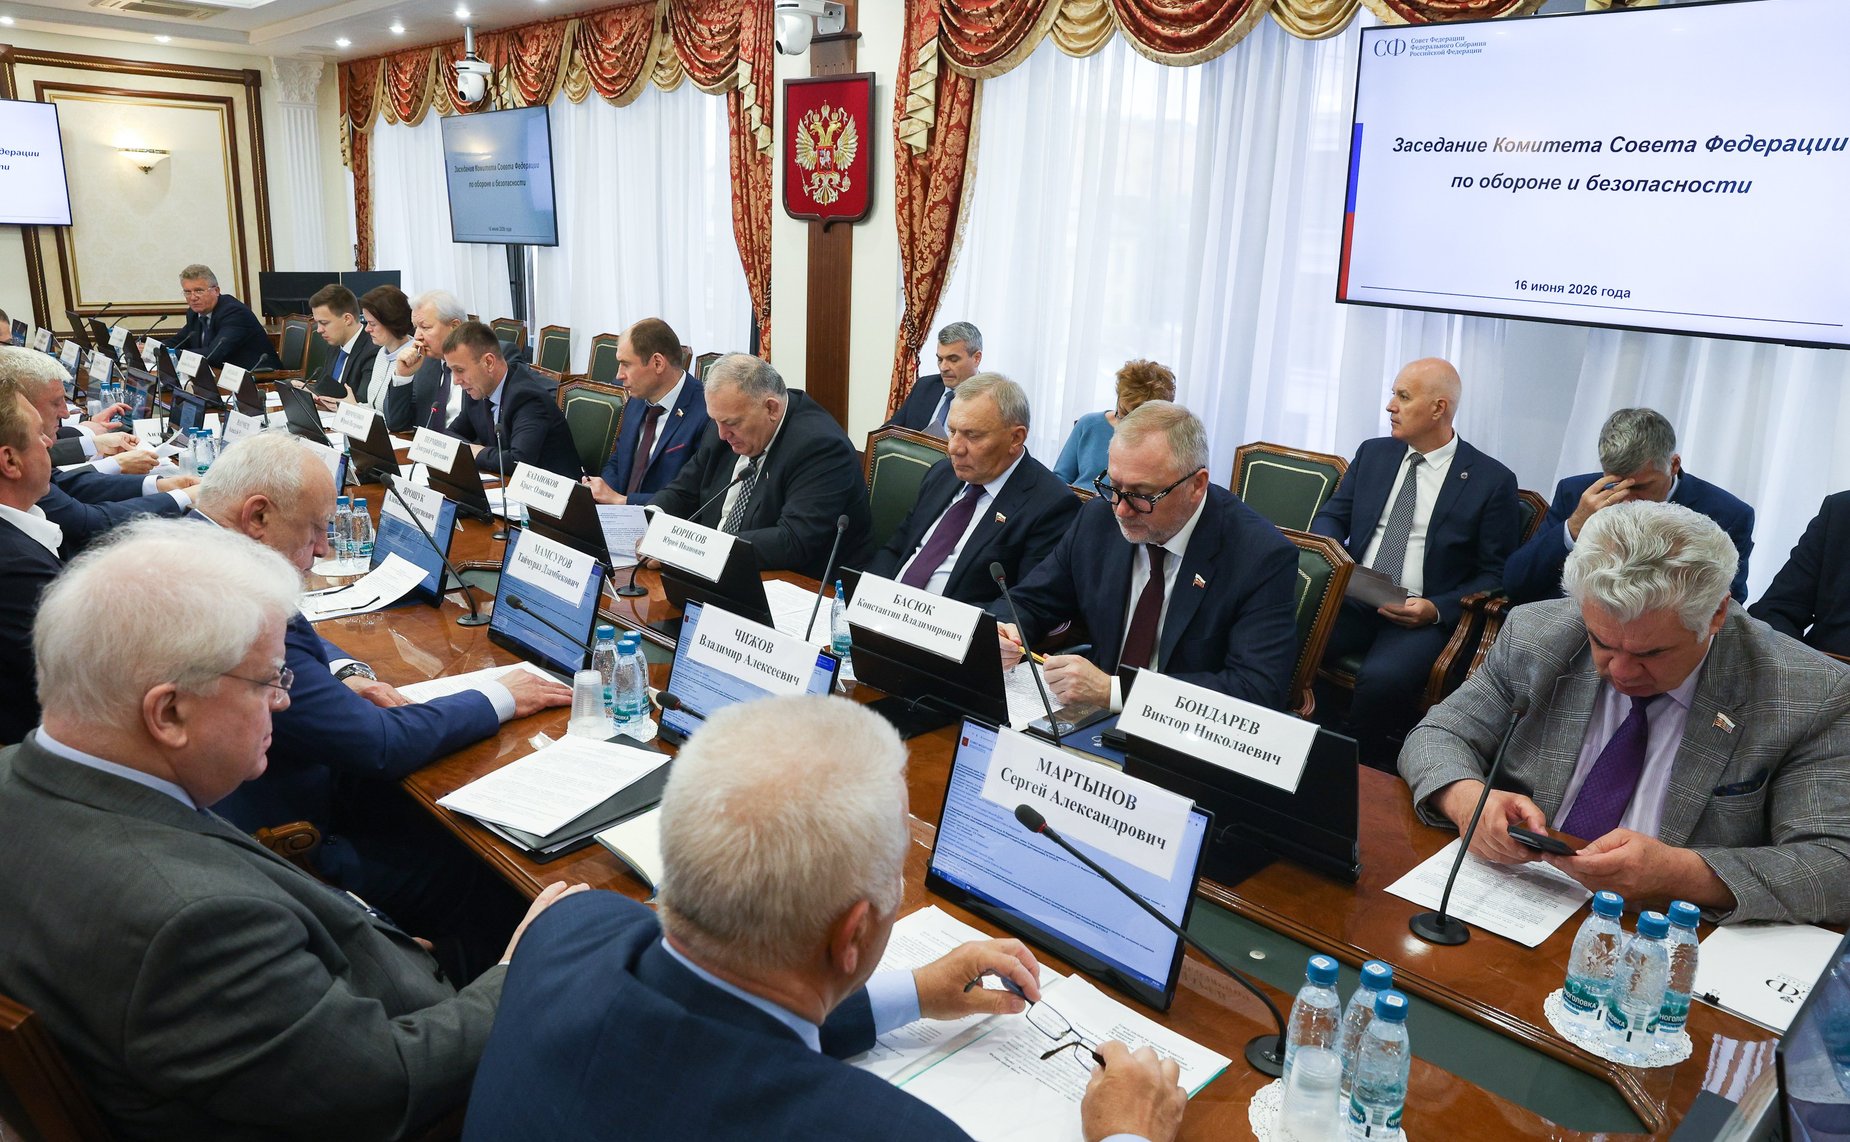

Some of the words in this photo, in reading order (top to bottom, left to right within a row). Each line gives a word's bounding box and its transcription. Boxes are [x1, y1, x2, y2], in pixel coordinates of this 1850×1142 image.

[1374, 38, 1406, 57] СФ
[1409, 49, 1446, 57] Российской
[1392, 137, 1488, 153] Заседание
[1493, 137, 1603, 153] Комитета
[1609, 136, 1697, 153] Совета
[1705, 134, 1849, 157] Федерации
[1451, 176, 1474, 188] по
[1479, 173, 1562, 193] обороне
[1567, 178, 1580, 191] и
[1586, 174, 1752, 194] безопасности
[1514, 280, 1528, 290] 16
[1531, 283, 1565, 293] июня
[1568, 284, 1598, 295] 2026
[1601, 288, 1631, 299] года
[663, 536, 678, 547] Юрий
[679, 542, 705, 557] Иванович
[671, 525, 707, 544] БОРИСОВ
[534, 544, 573, 569] МАМСУРОВ
[893, 594, 935, 616] БАСЮК
[857, 598, 901, 620] Константин
[902, 613, 962, 641] Владимирович
[734, 628, 774, 654] ЧИЖОВ
[699, 634, 742, 663] Владимир
[744, 654, 800, 686] Алексеевич
[1174, 695, 1261, 735] БОНДАРЕВ
[1142, 704, 1190, 733] Виктор
[1194, 723, 1282, 766] Николаевич
[1036, 757, 1137, 811] МАРТЫНОВ
[1000, 767, 1047, 799] Сергей
[1050, 790, 1167, 850] Александрович
